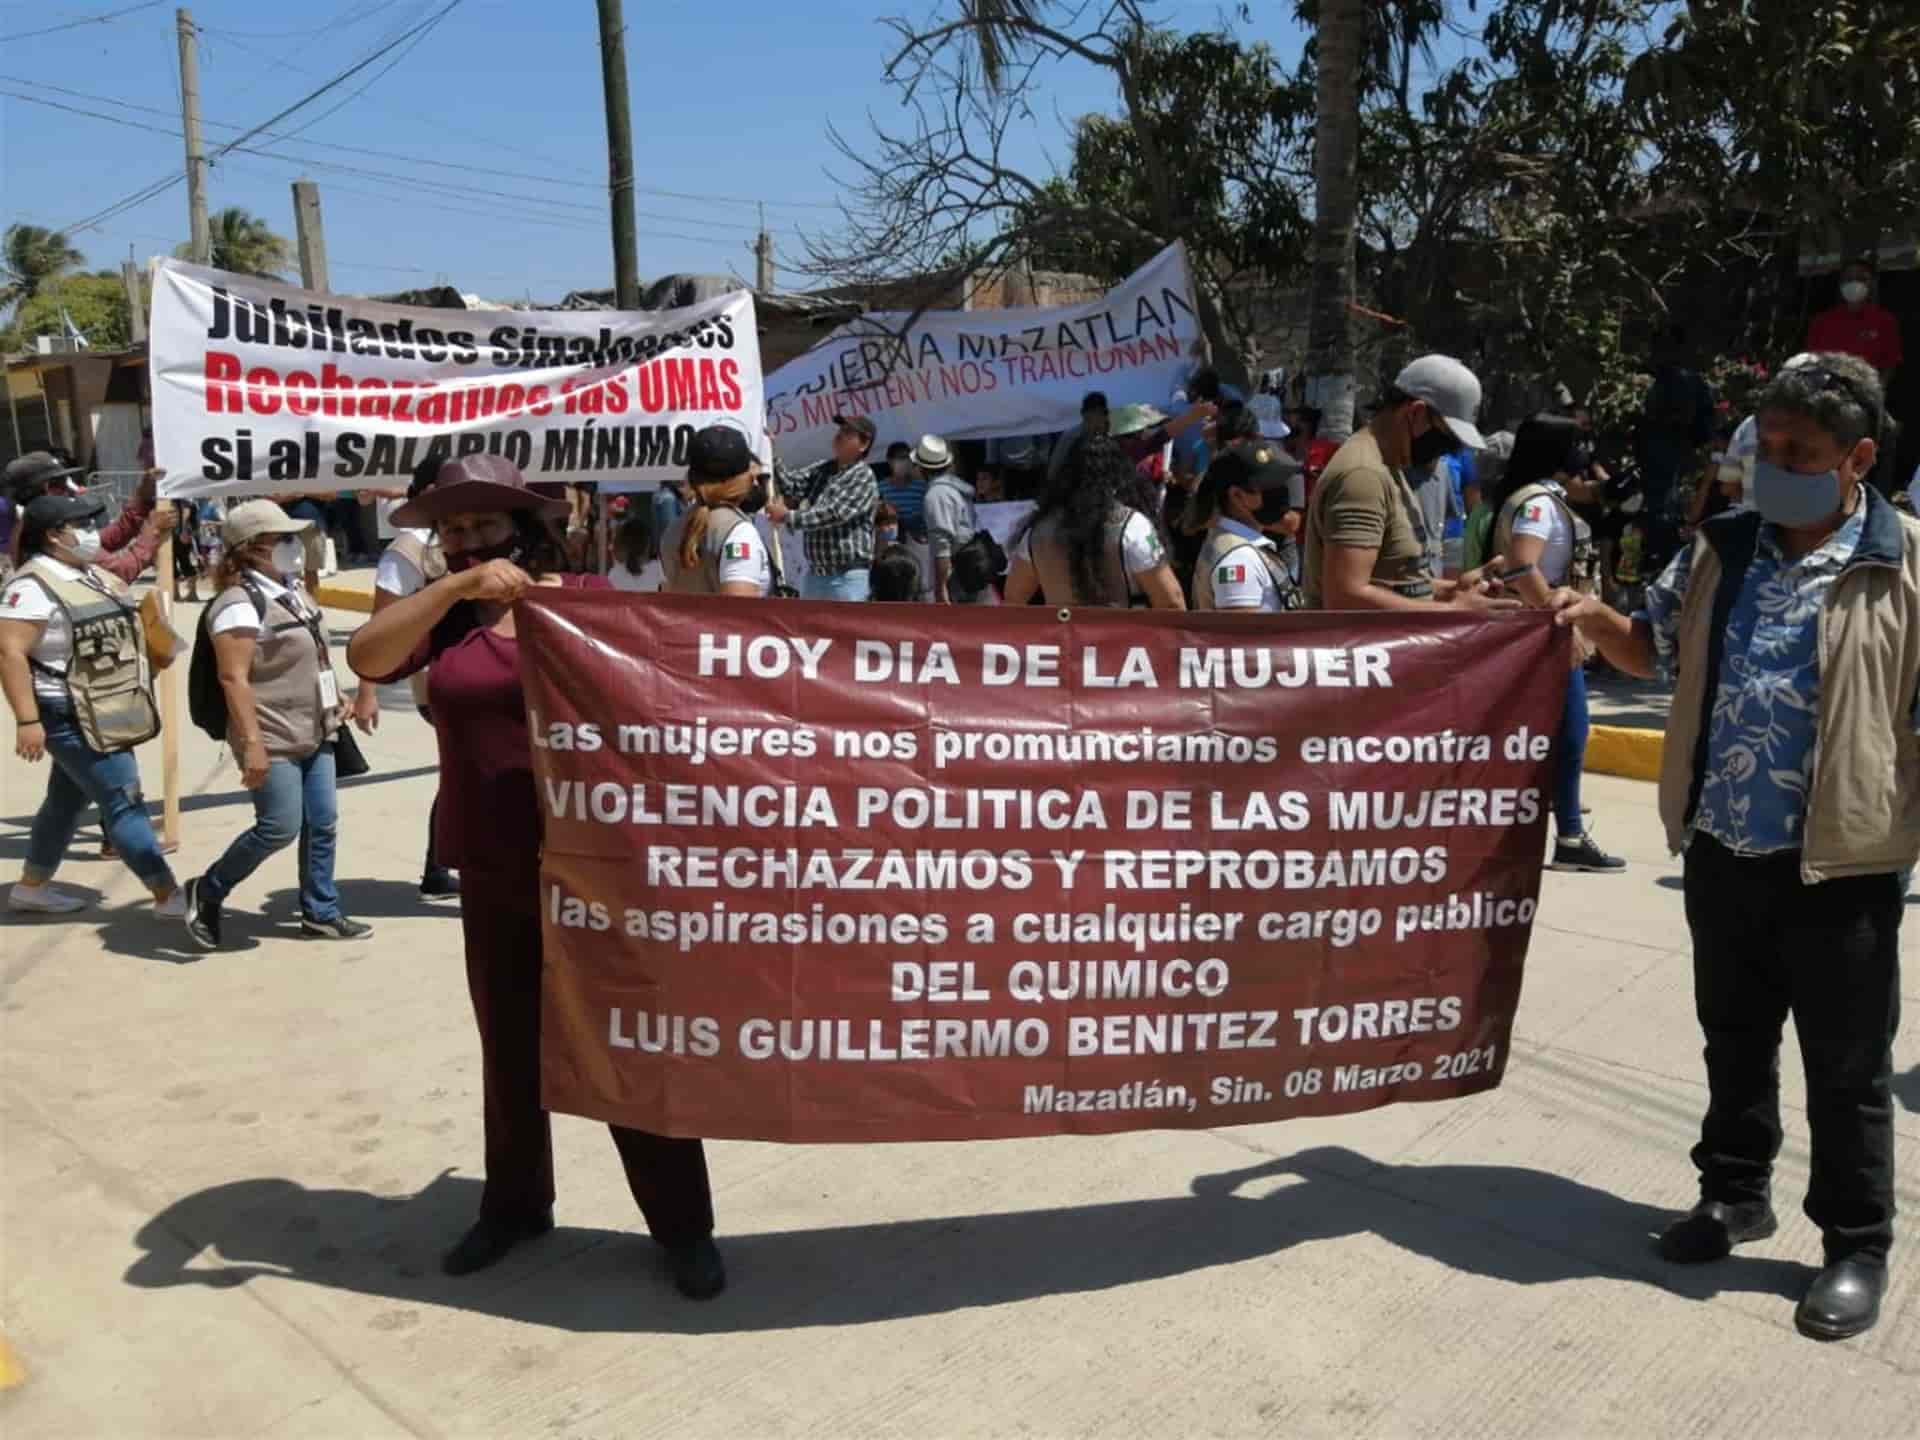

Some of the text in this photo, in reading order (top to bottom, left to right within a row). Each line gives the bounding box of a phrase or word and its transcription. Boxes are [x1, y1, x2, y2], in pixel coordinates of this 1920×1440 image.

[208, 287, 478, 364] Jubilados
[638, 358, 742, 413] UMAS
[940, 359, 997, 397] NOS
[202, 429, 252, 481] si
[268, 431, 320, 481] al
[699, 633, 1394, 689] HOY DIA DE LA MUJER
[530, 709, 602, 752] Las
[619, 717, 816, 765] mujeres
[834, 728, 918, 760] nos
[1301, 729, 1491, 763] encontra
[1503, 726, 1552, 762] de
[545, 777, 1541, 831] VIOLENCIA POLITICA DE LAS MUJERES
[647, 845, 1448, 890] RECHAZAMOS Y REPROBAMOS
[549, 885, 1535, 952] las aspirasiones a cualquier cargo publico
[891, 957, 1230, 1003] DEL QUIMICO
[608, 995, 1462, 1061] LUIS GUILLERMO BENITEZ TORRES
[1023, 1043, 1497, 1114] Mazatlán, Sin. 08 Marzo 2021
